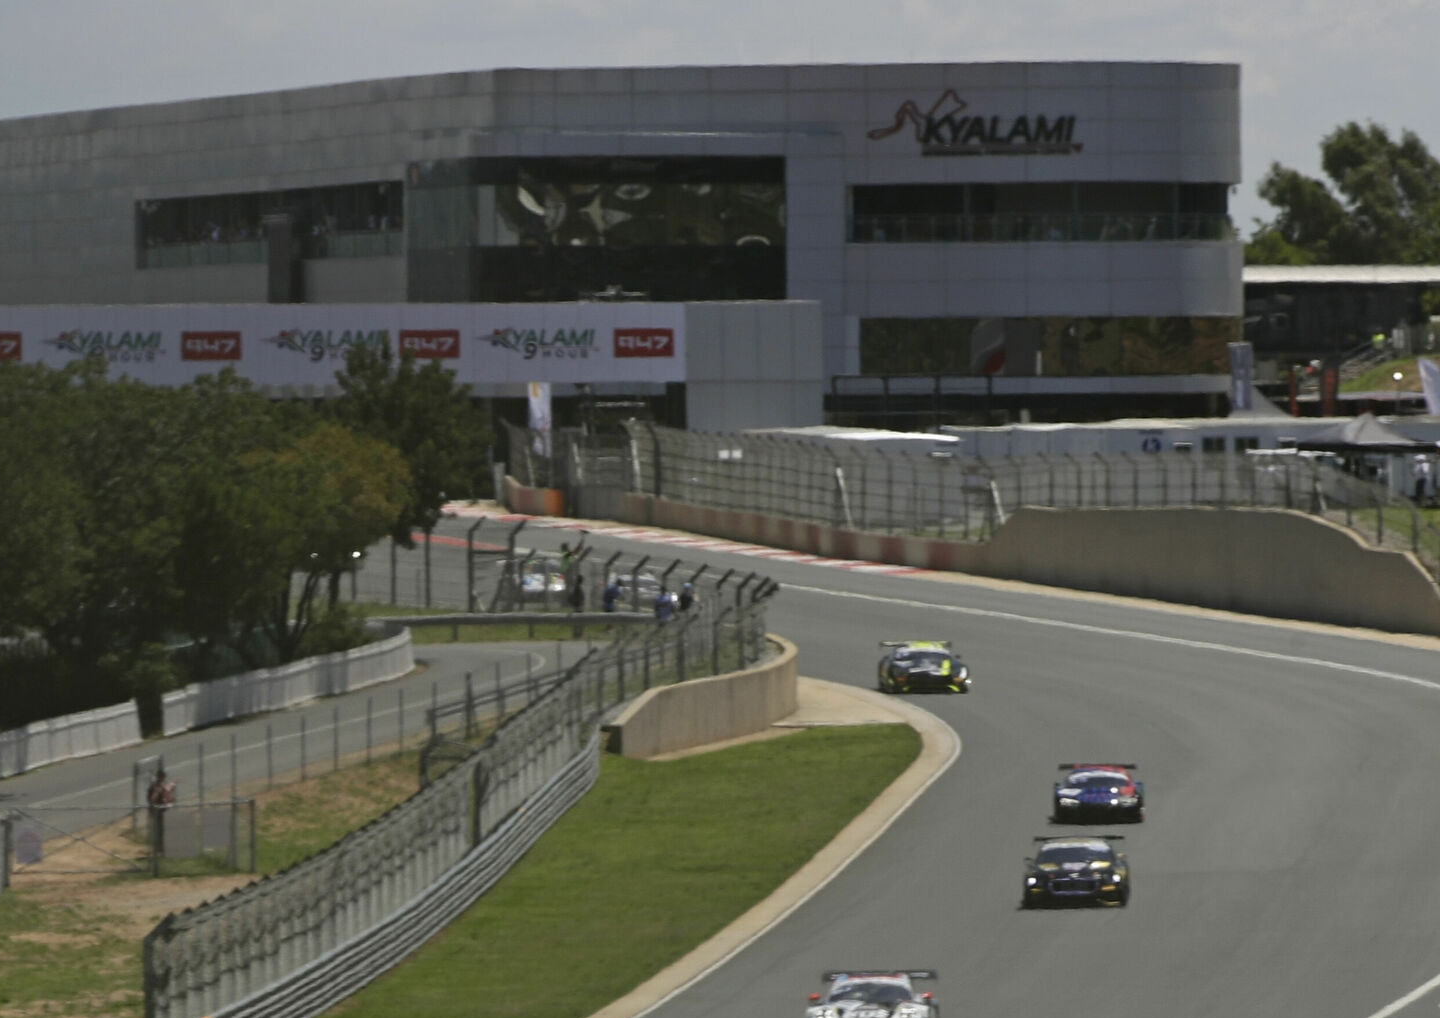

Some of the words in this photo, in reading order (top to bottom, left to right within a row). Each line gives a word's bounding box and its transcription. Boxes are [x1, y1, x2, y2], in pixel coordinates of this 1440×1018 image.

[920, 114, 1077, 145] KYALAMI
[48, 330, 163, 355] KYALAMI
[185, 337, 238, 353] 947
[403, 336, 456, 350] 947
[475, 327, 596, 352] KYALAMI
[617, 336, 671, 350] 947
[523, 341, 538, 361] 9
[541, 349, 589, 360] HOUR
